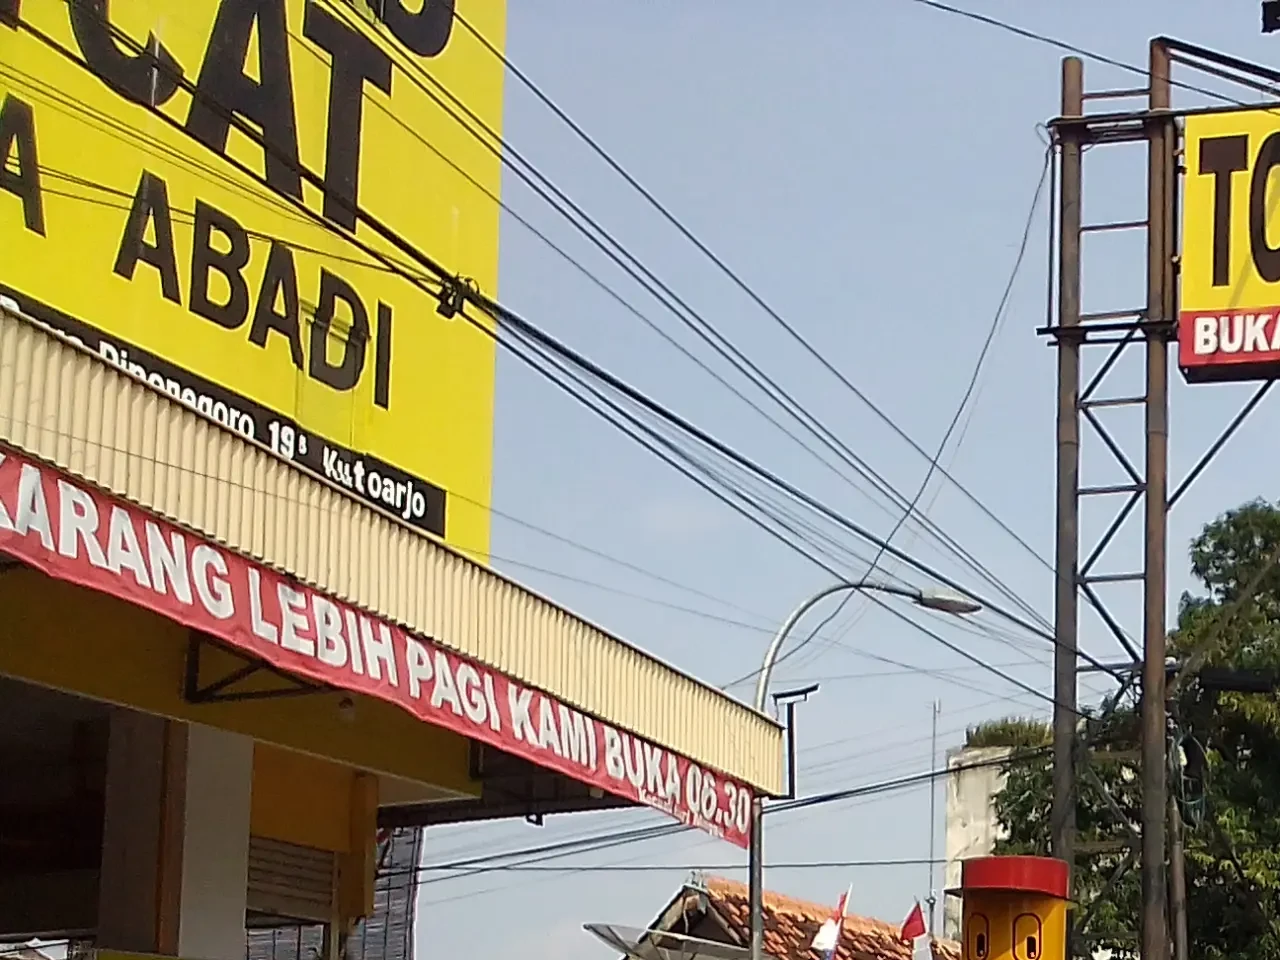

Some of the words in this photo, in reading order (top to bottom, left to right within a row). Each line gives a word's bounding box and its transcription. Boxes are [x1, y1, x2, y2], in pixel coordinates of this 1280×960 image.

[112, 168, 393, 411] ABADI
[323, 446, 426, 520] Kutoarjo
[248, 566, 398, 688] LEBIH
[406, 636, 501, 732] PAGI
[508, 682, 597, 770] KAMI
[604, 725, 680, 805] BUKA
[686, 764, 750, 834] 06.30
